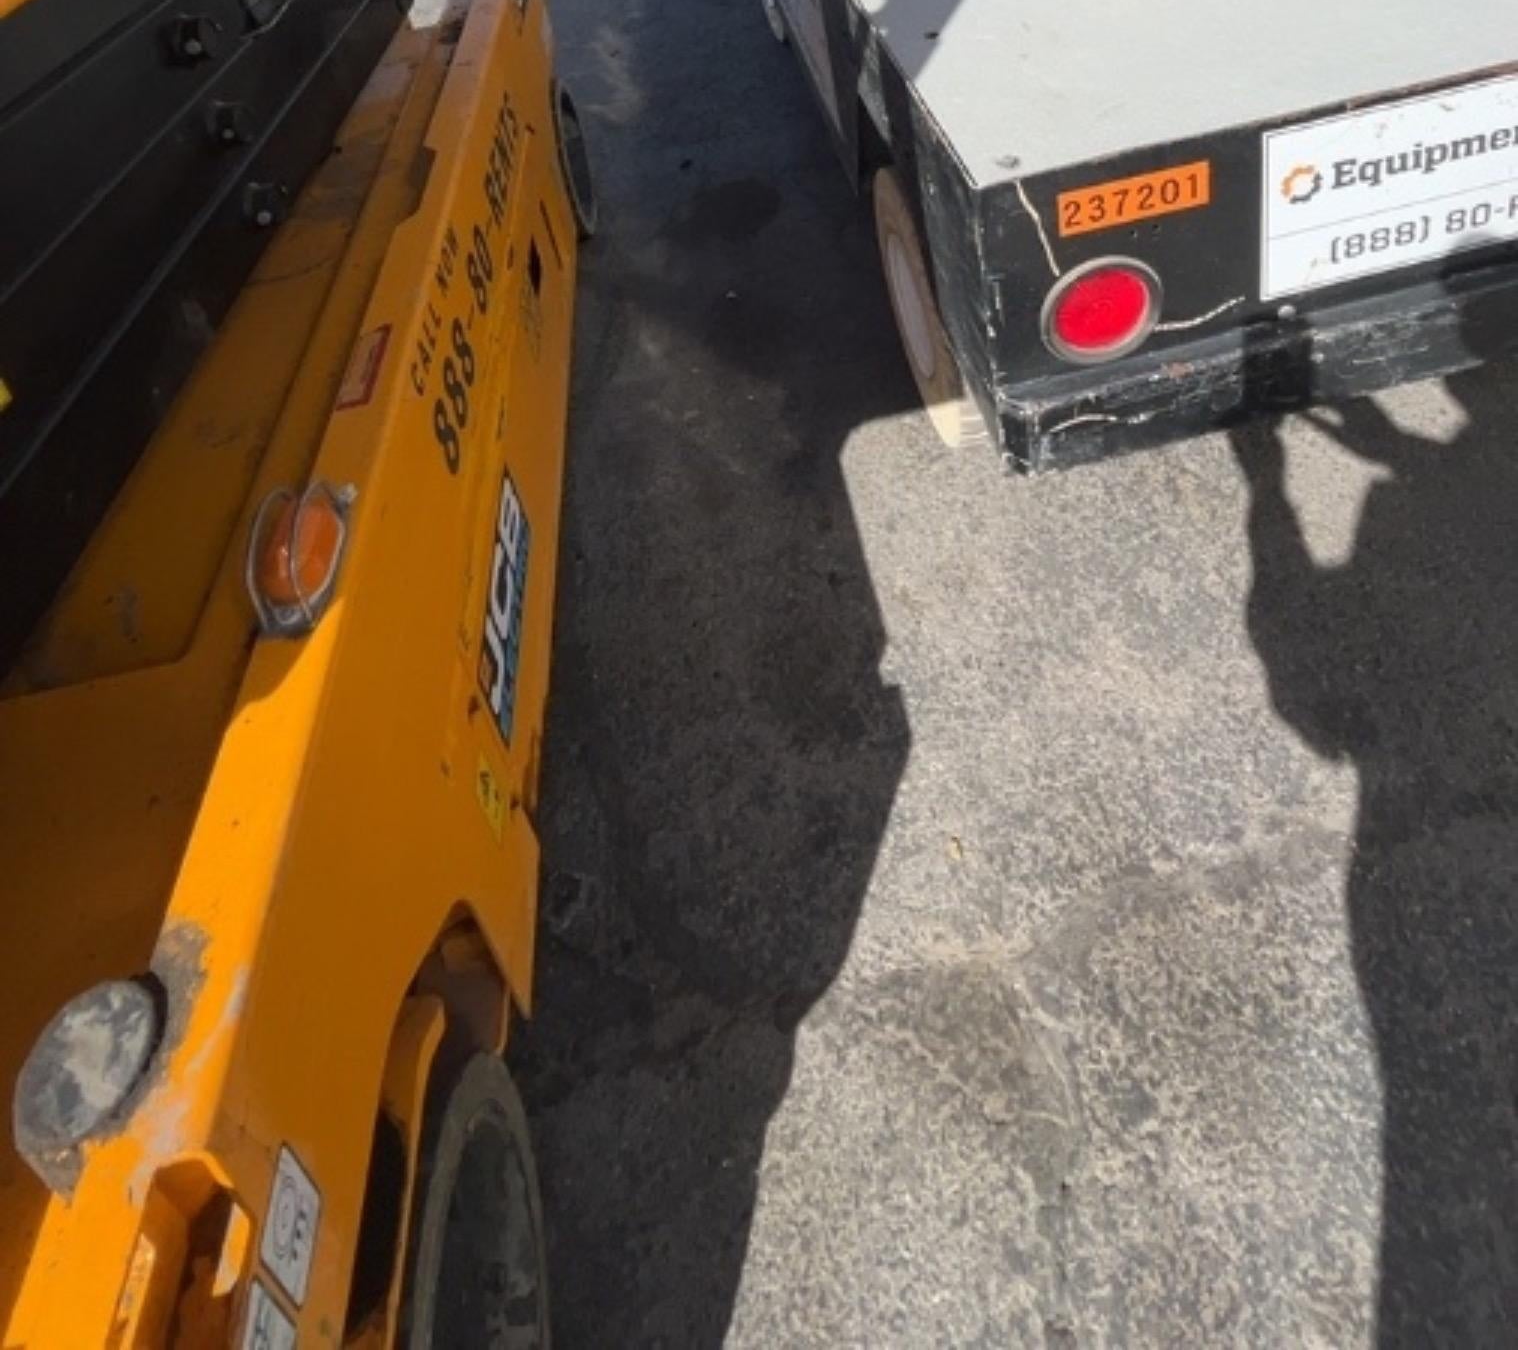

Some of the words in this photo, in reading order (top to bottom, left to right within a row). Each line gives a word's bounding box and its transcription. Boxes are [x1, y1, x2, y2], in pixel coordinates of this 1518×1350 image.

[1332, 124, 1518, 189] Equipme
[1063, 172, 1198, 229] 237201
[1330, 216, 1431, 264] (888)
[485, 475, 521, 715] JCB
